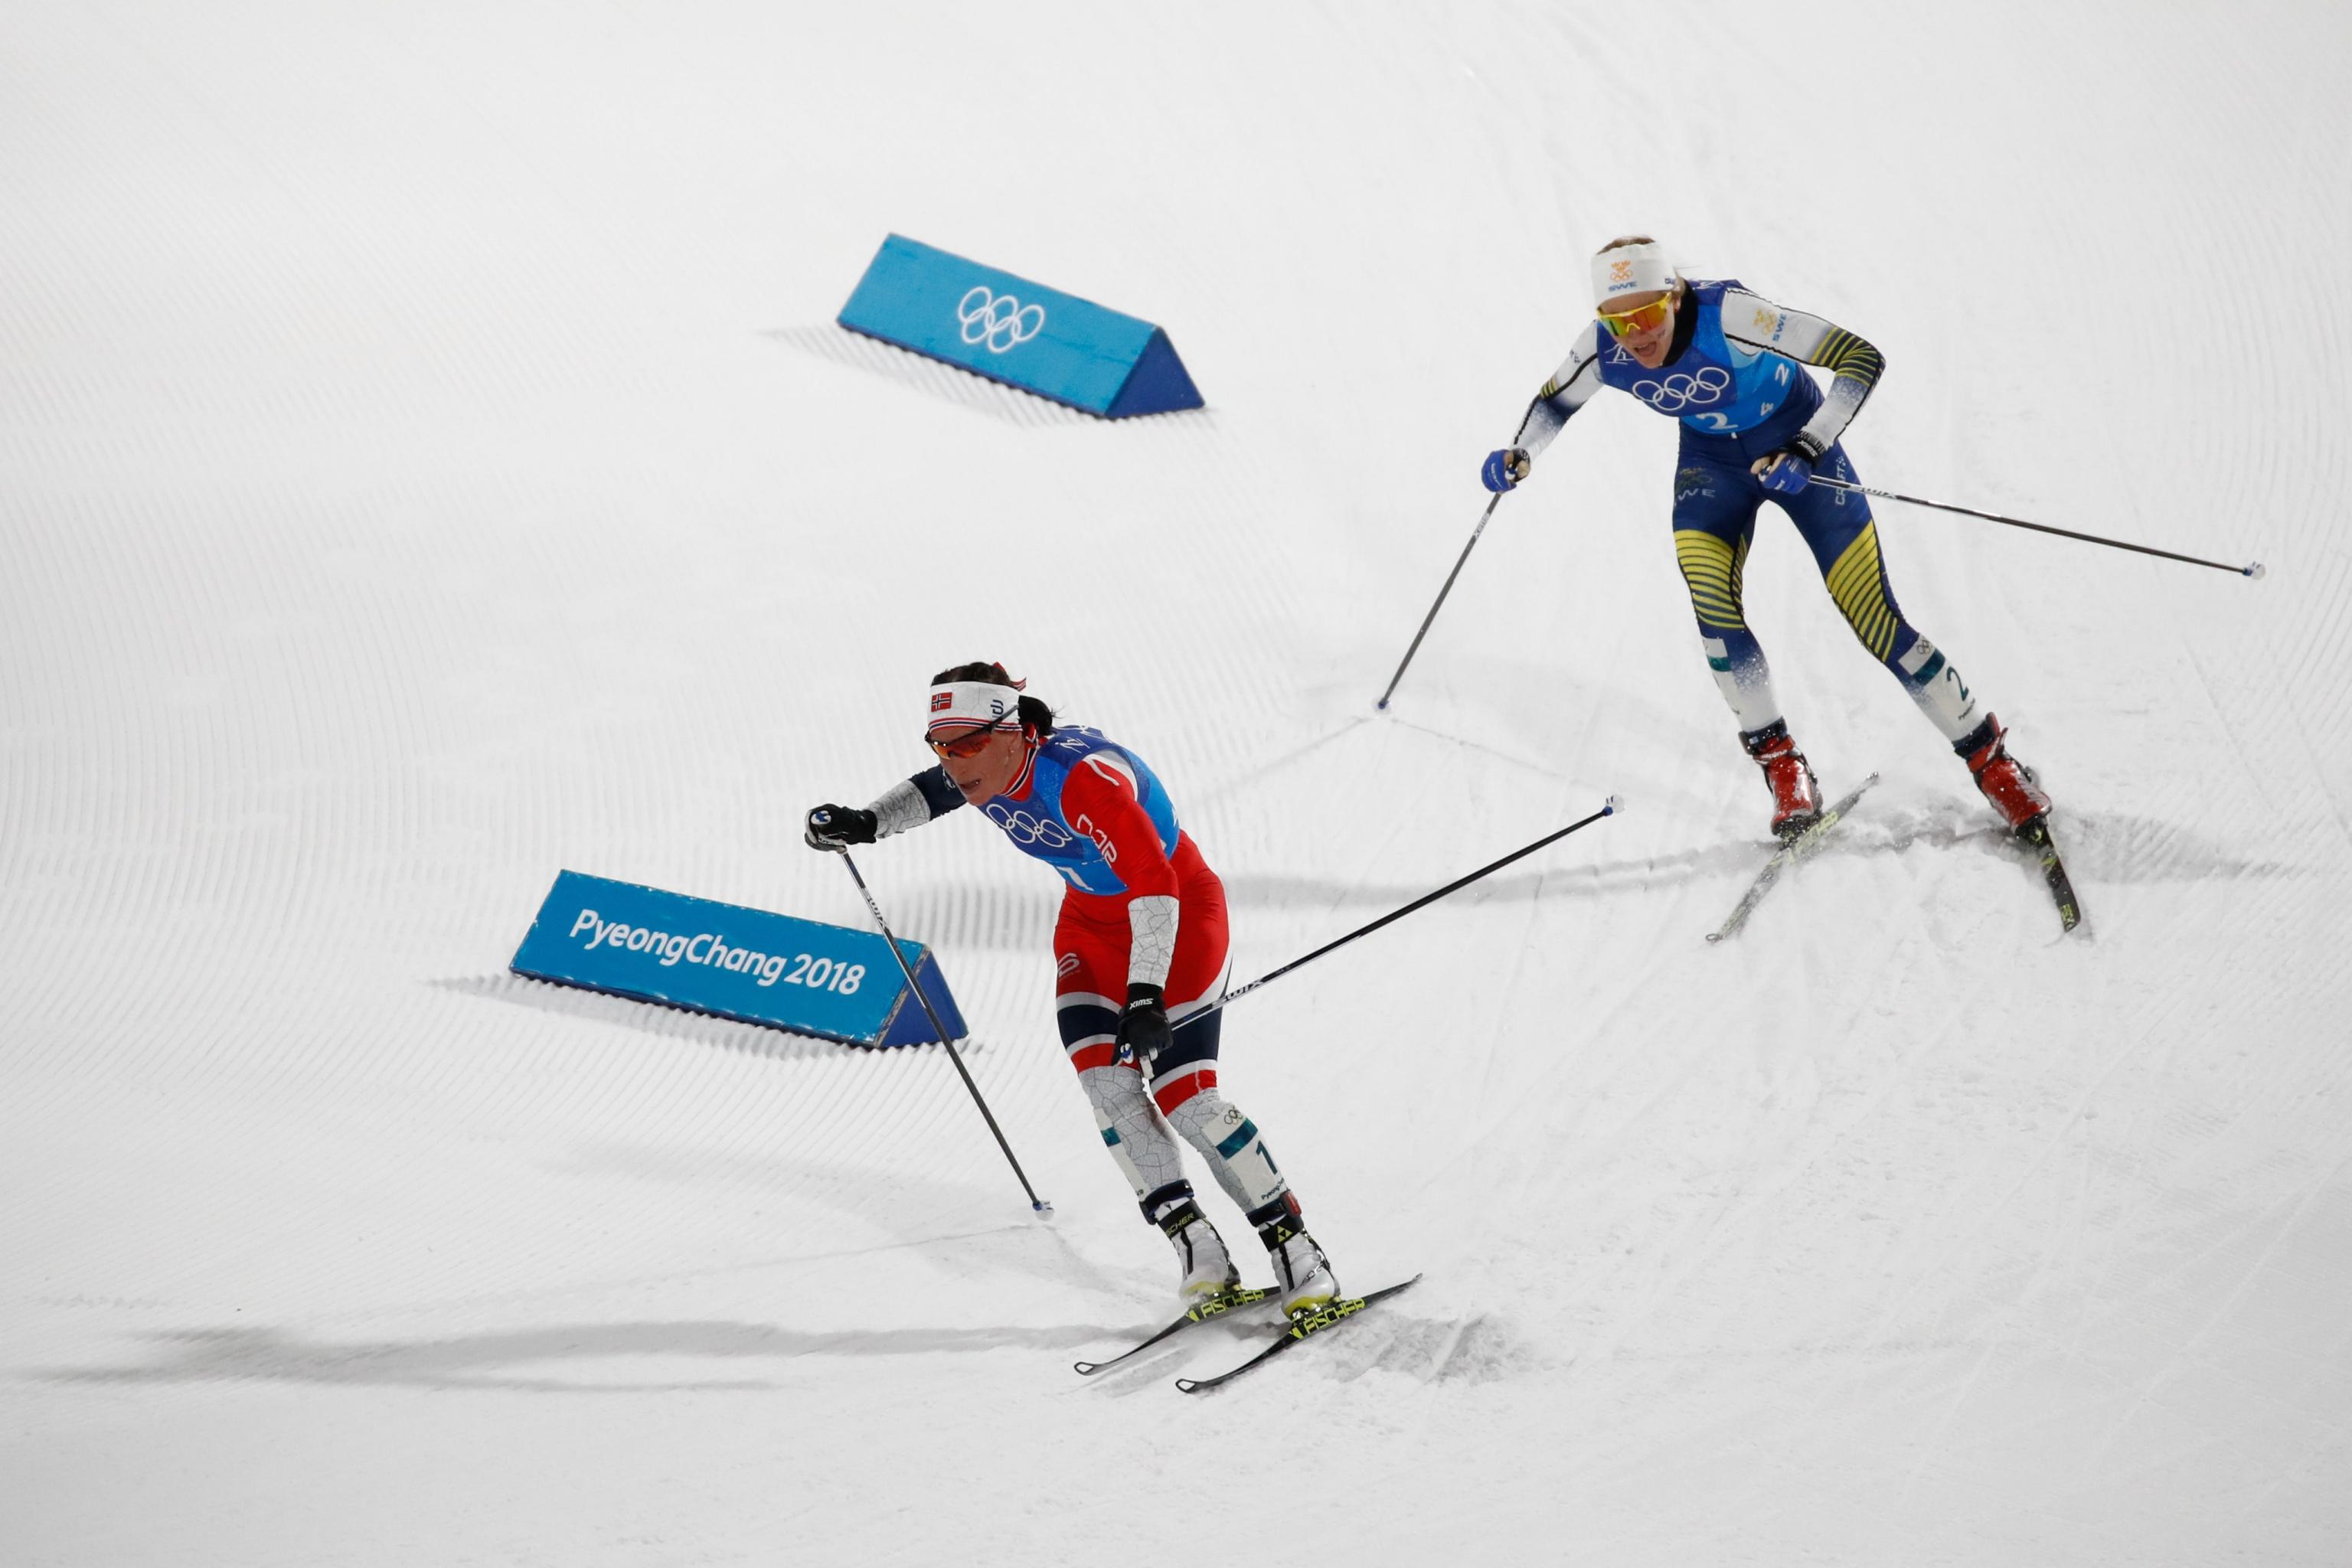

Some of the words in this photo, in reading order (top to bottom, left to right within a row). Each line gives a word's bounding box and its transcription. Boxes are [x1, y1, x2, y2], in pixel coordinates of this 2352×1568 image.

[1609, 280, 1638, 292] SWE
[1772, 313, 1787, 342] SWE
[1696, 412, 1739, 430] 2
[1674, 488, 1715, 507] WE
[1835, 465, 1847, 505] CRFT
[1946, 666, 1969, 701] 2
[569, 908, 789, 987] PyeongChang
[784, 953, 866, 995] 2018
[1256, 1140, 1278, 1174] 1
[1200, 1289, 1265, 1318] FISCHER
[1304, 1298, 1366, 1334] FISCHER
